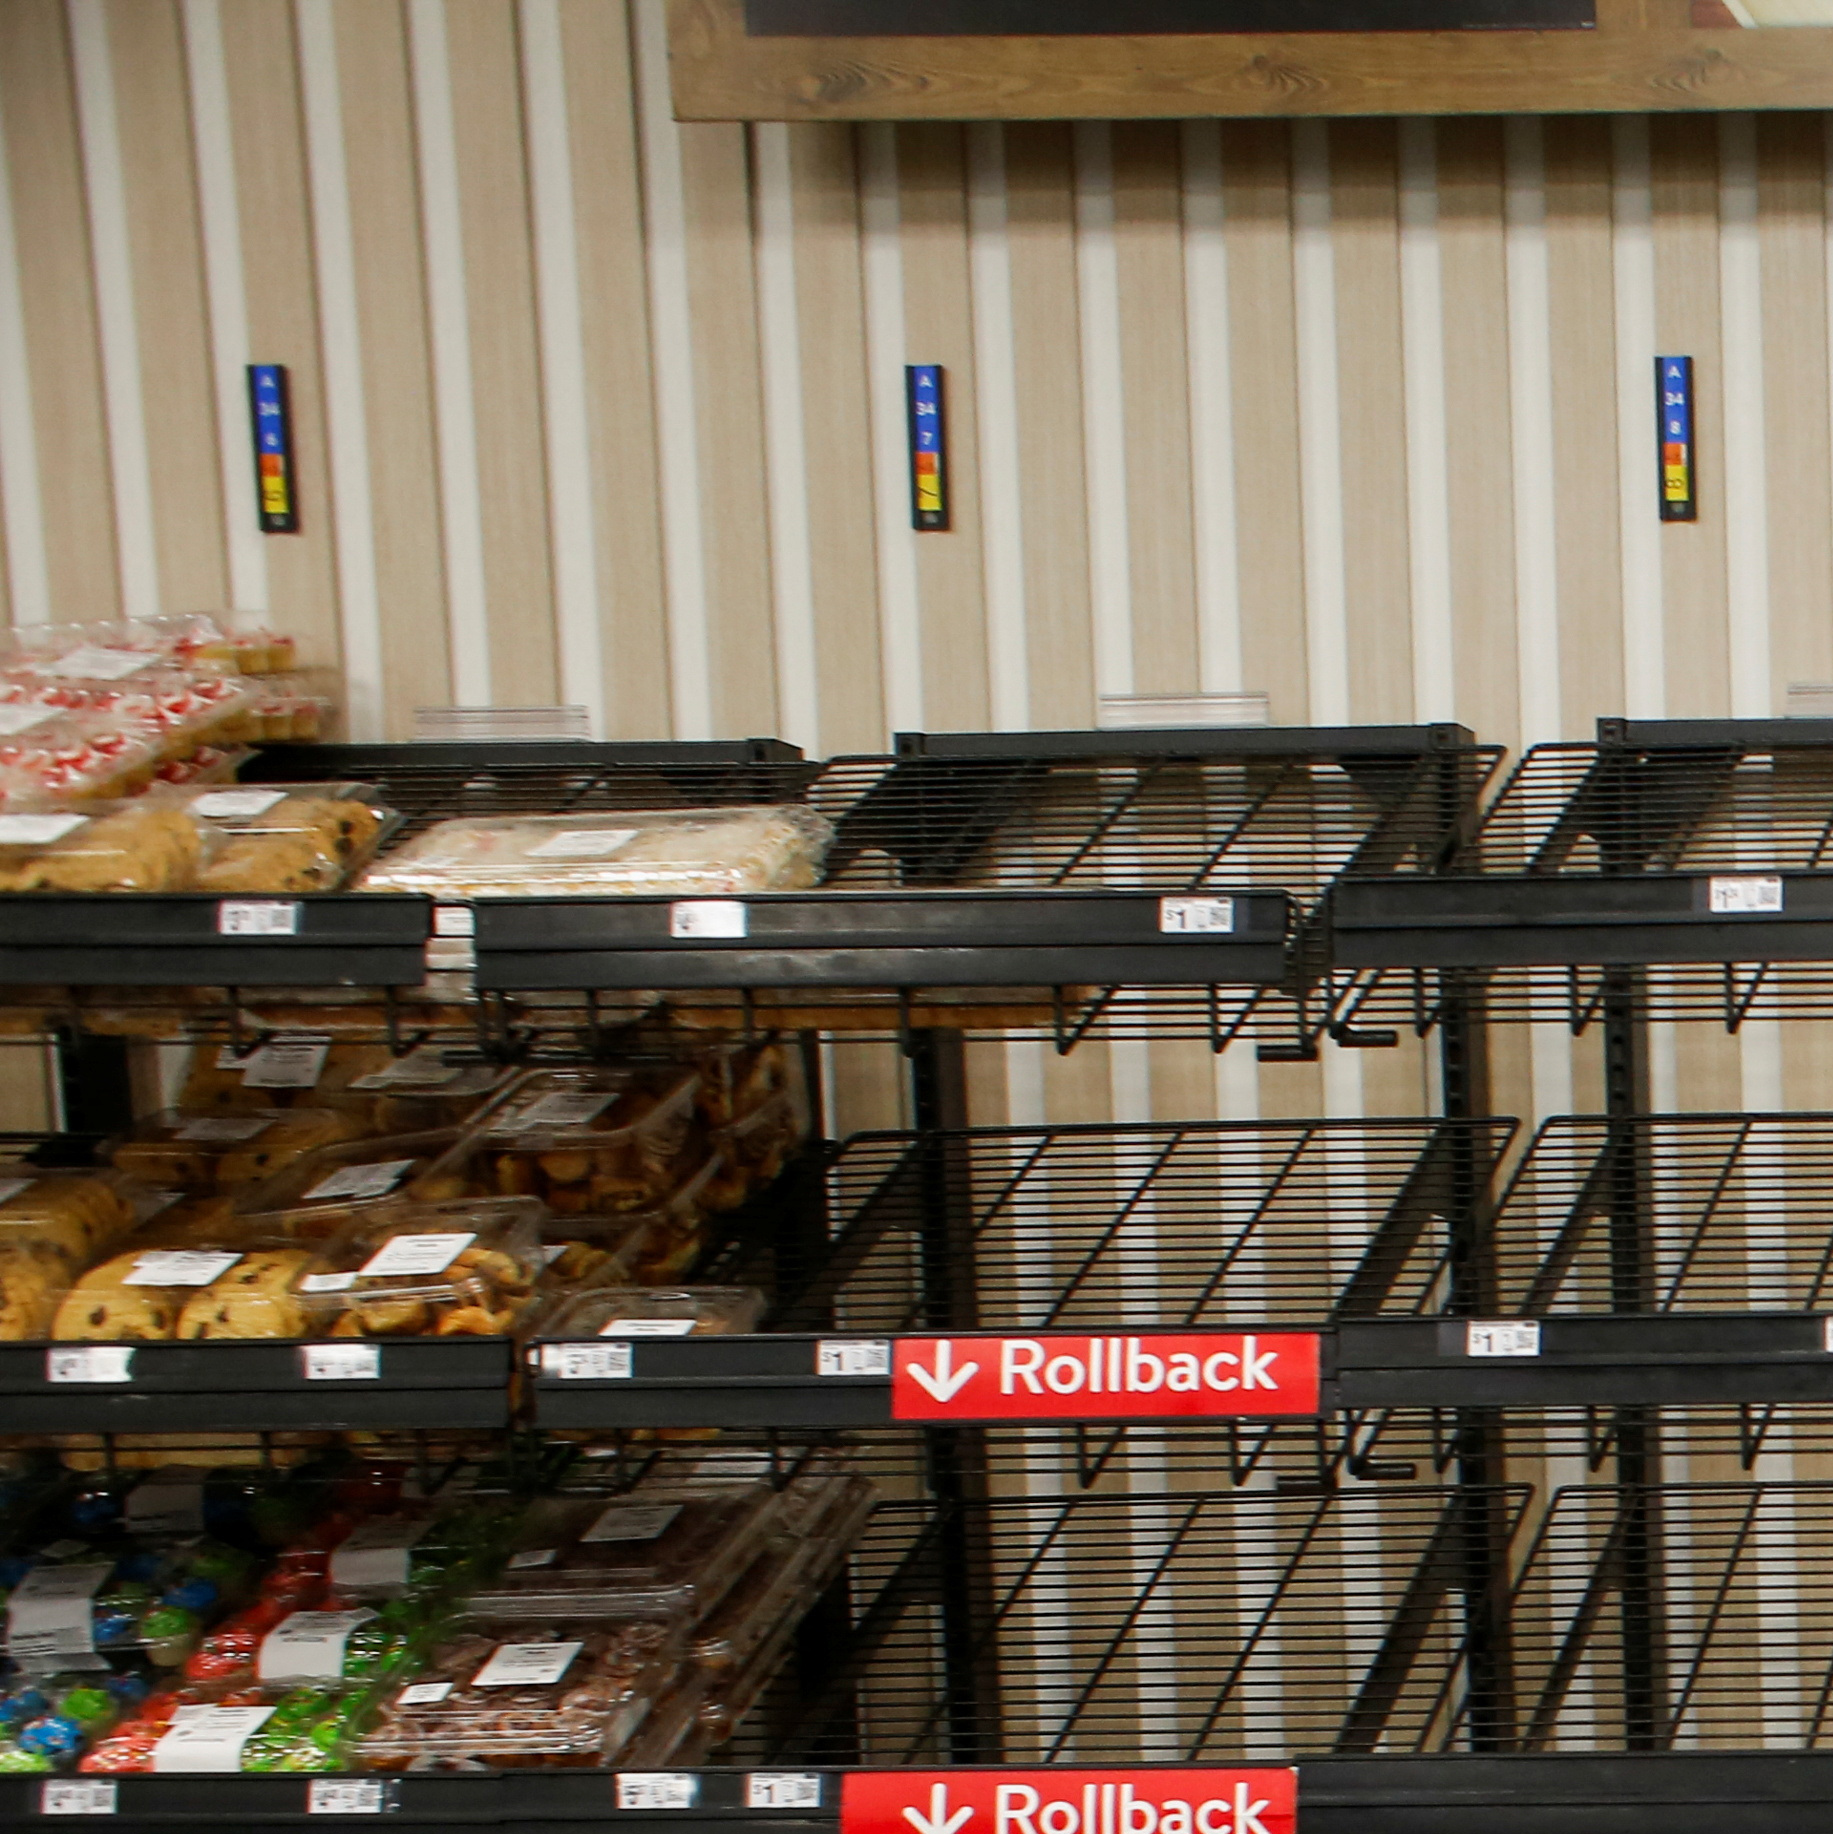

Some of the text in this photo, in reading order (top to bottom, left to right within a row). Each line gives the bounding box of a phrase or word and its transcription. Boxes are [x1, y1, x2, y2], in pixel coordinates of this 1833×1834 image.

[1668, 365, 1681, 379] A
[919, 374, 934, 389] A
[1000, 1335, 1279, 1396] Rollback
